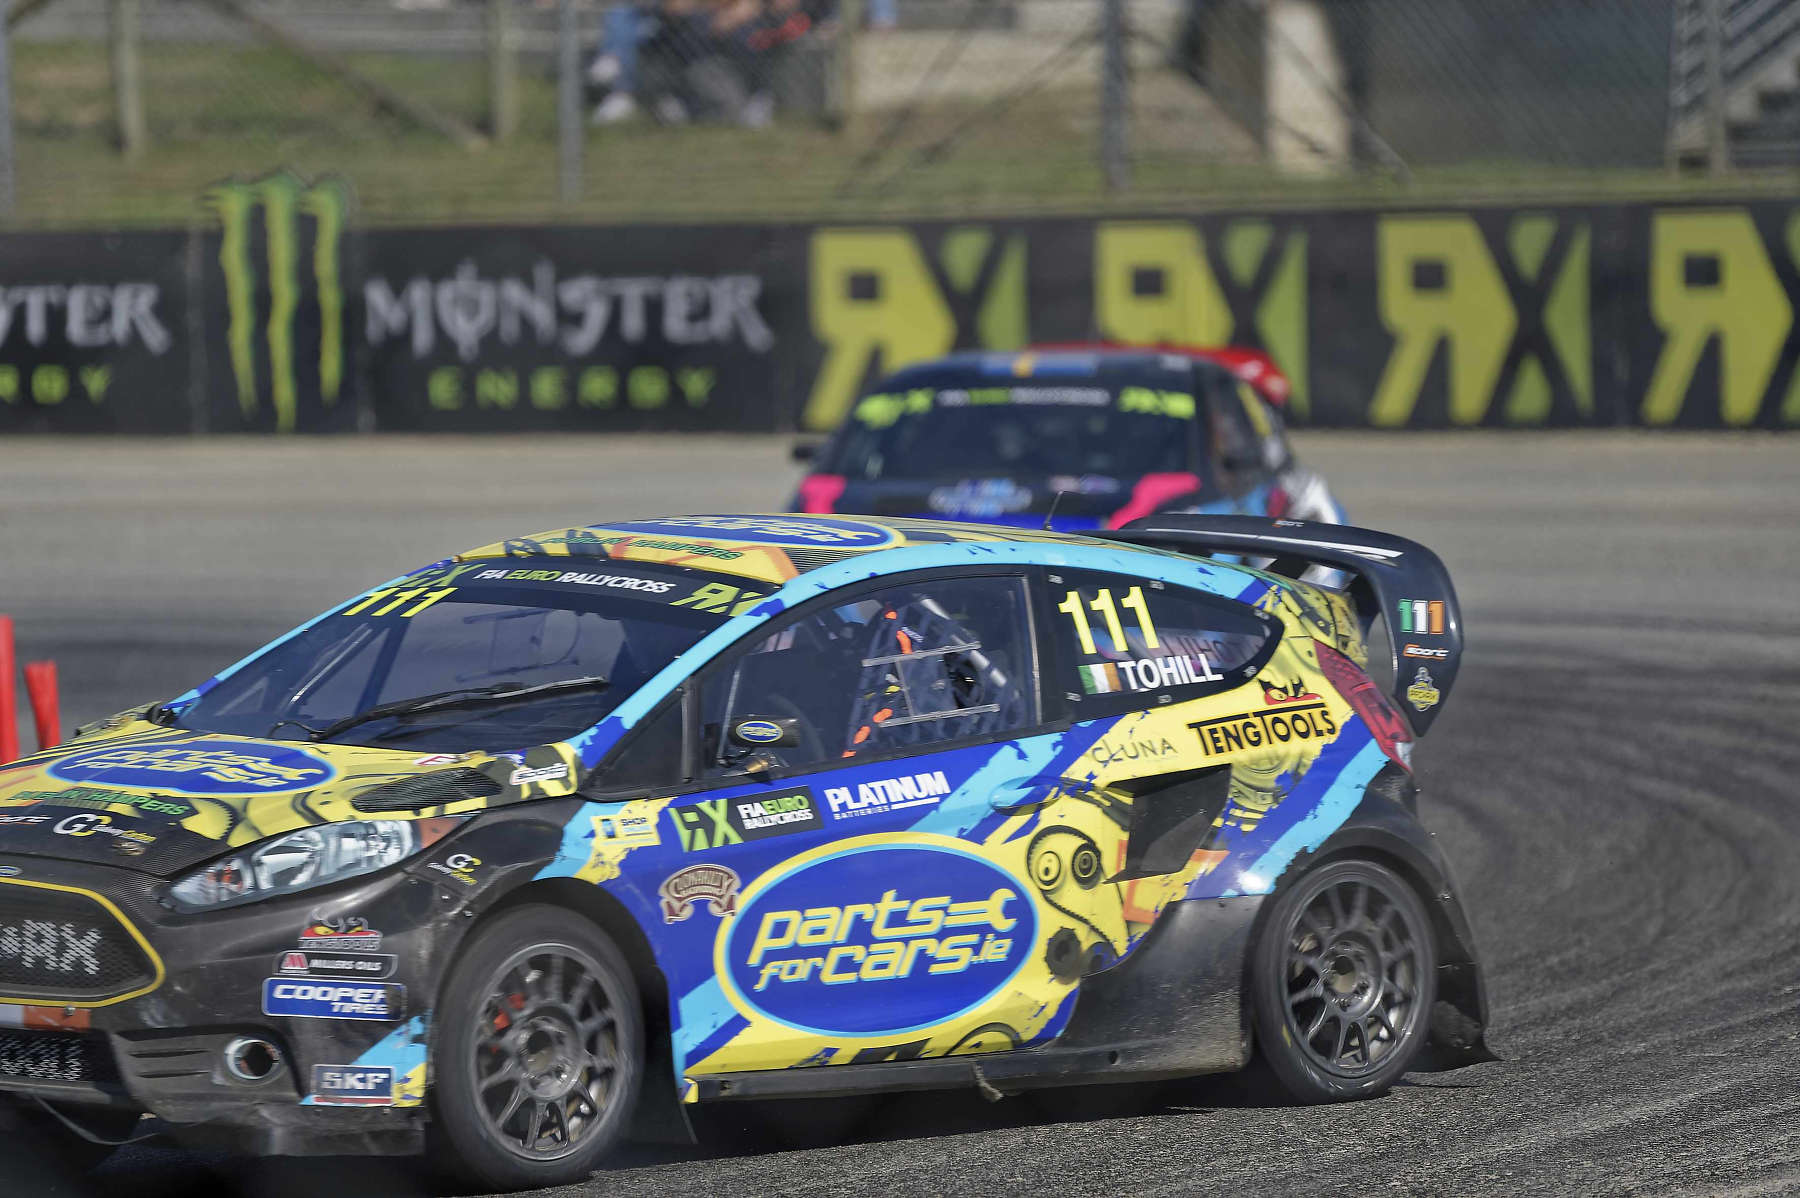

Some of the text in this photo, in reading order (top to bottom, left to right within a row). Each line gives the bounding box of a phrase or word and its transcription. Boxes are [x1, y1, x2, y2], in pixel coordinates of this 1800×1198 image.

[0, 283, 172, 356] TER
[364, 259, 774, 360] MONSTER
[1369, 212, 1595, 427] RX
[427, 365, 716, 411] ENERGY
[342, 587, 459, 617] 111
[503, 570, 563, 582] EURO
[555, 572, 677, 594] RALLYCROSS
[1058, 586, 1160, 655] 111
[1397, 598, 1445, 635] 111
[1118, 653, 1224, 691] TOHILL
[824, 771, 951, 813] PLATINUM
[833, 804, 891, 821] BATTERIES
[746, 889, 952, 968] parts
[753, 957, 825, 992] for
[320, 1071, 390, 1091] SKF
